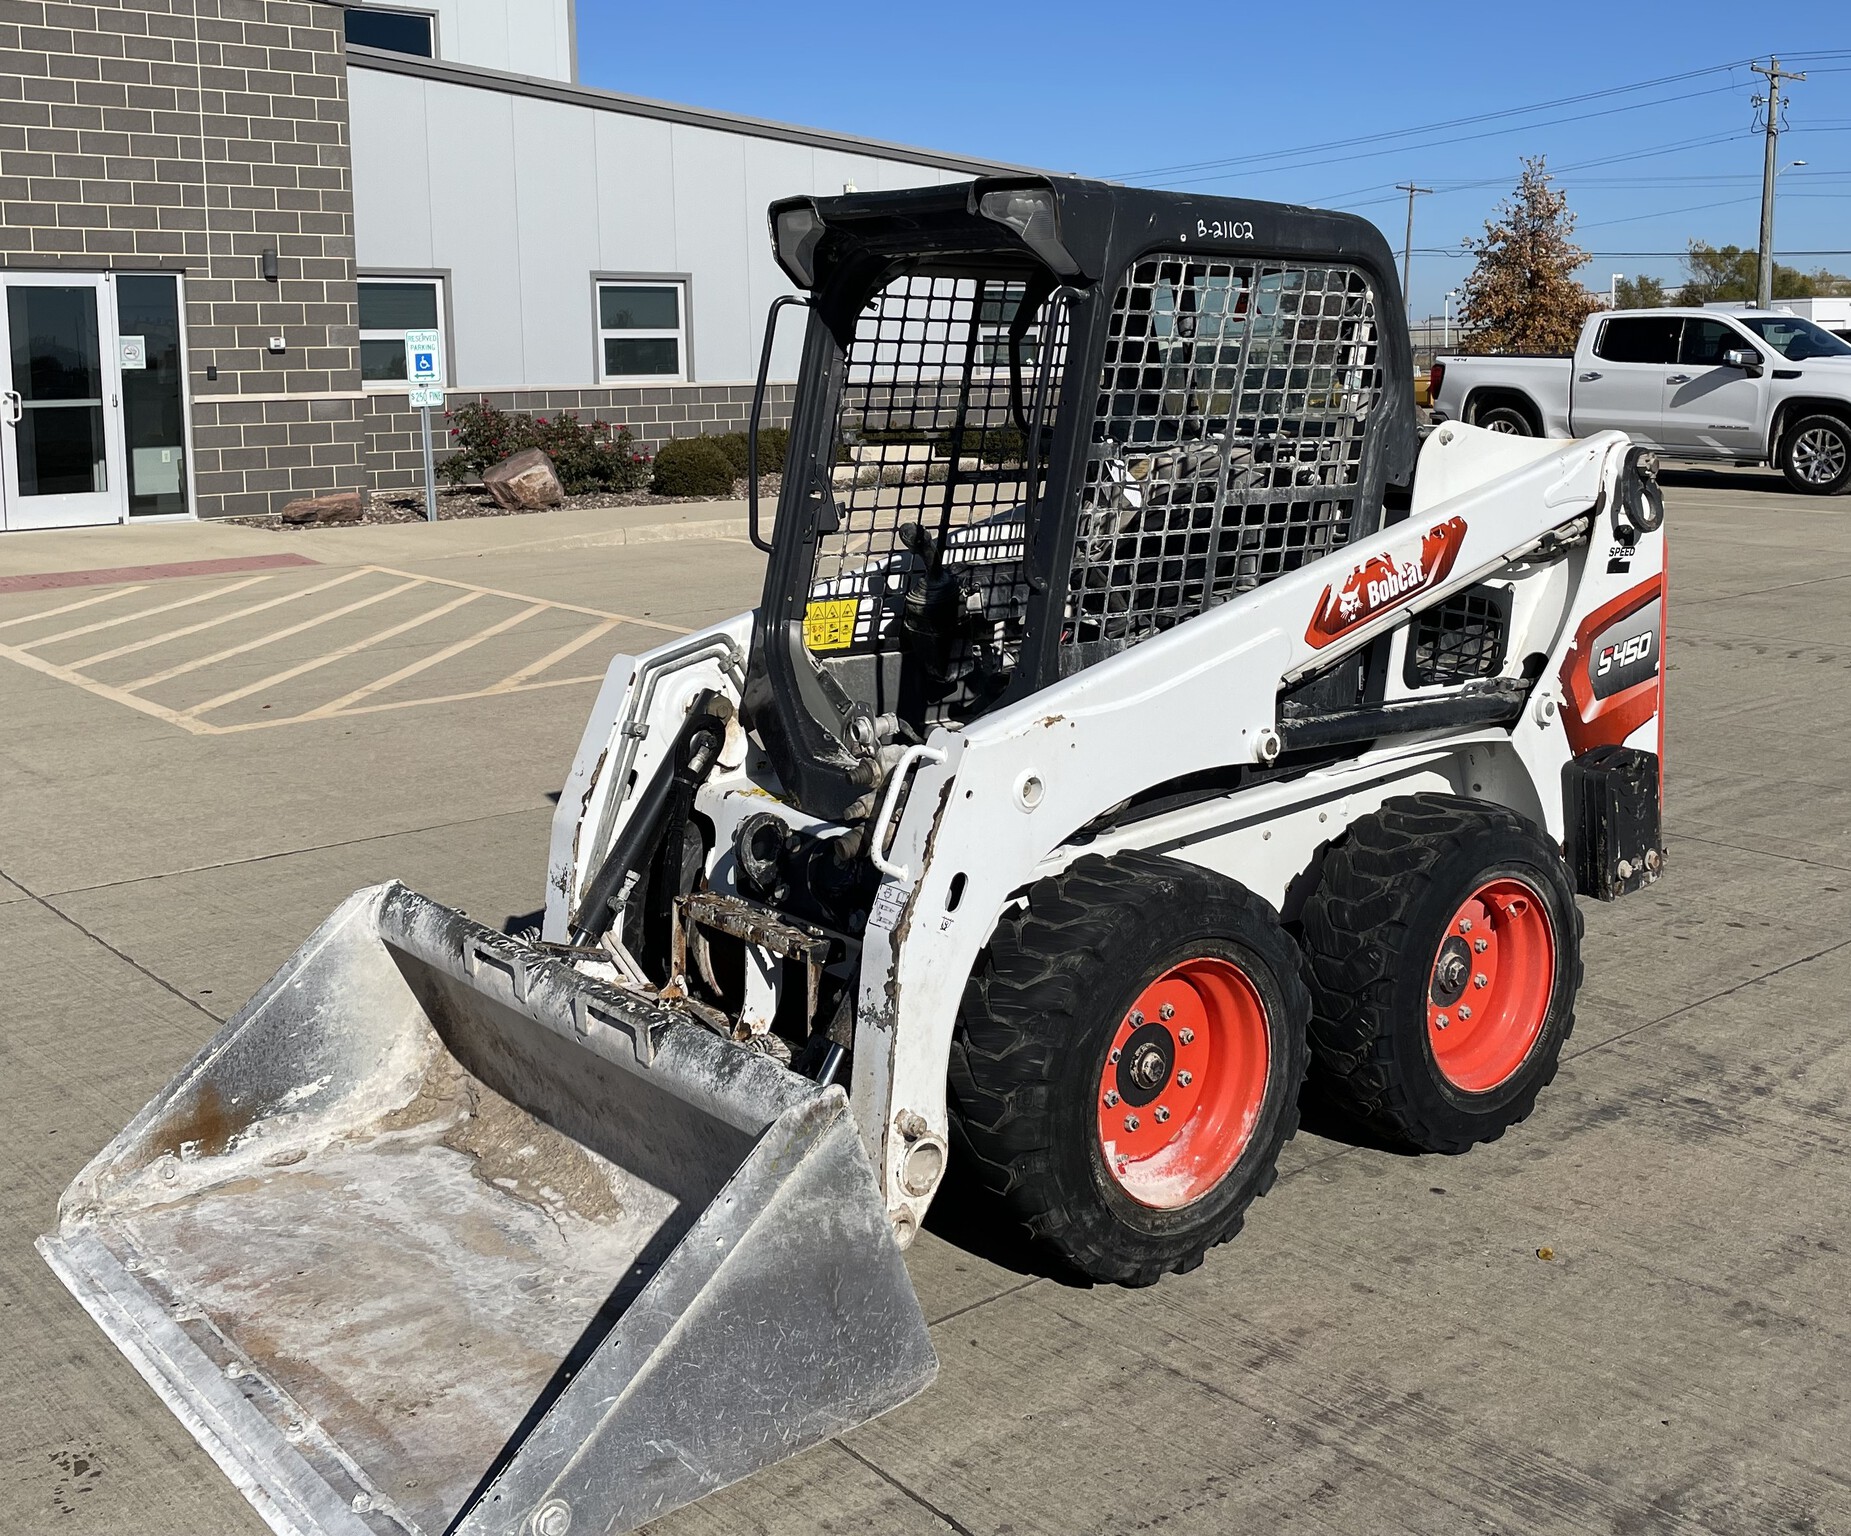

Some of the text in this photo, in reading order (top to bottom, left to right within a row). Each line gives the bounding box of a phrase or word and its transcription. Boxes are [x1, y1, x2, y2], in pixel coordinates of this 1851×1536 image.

[1197, 219, 1254, 240] B-21102
[407, 335, 437, 343] RESERVED
[411, 391, 442, 402] $250 FINE
[1608, 546, 1636, 557] SPEED
[1366, 563, 1424, 609] Bobcat
[1597, 631, 1653, 677] S450
